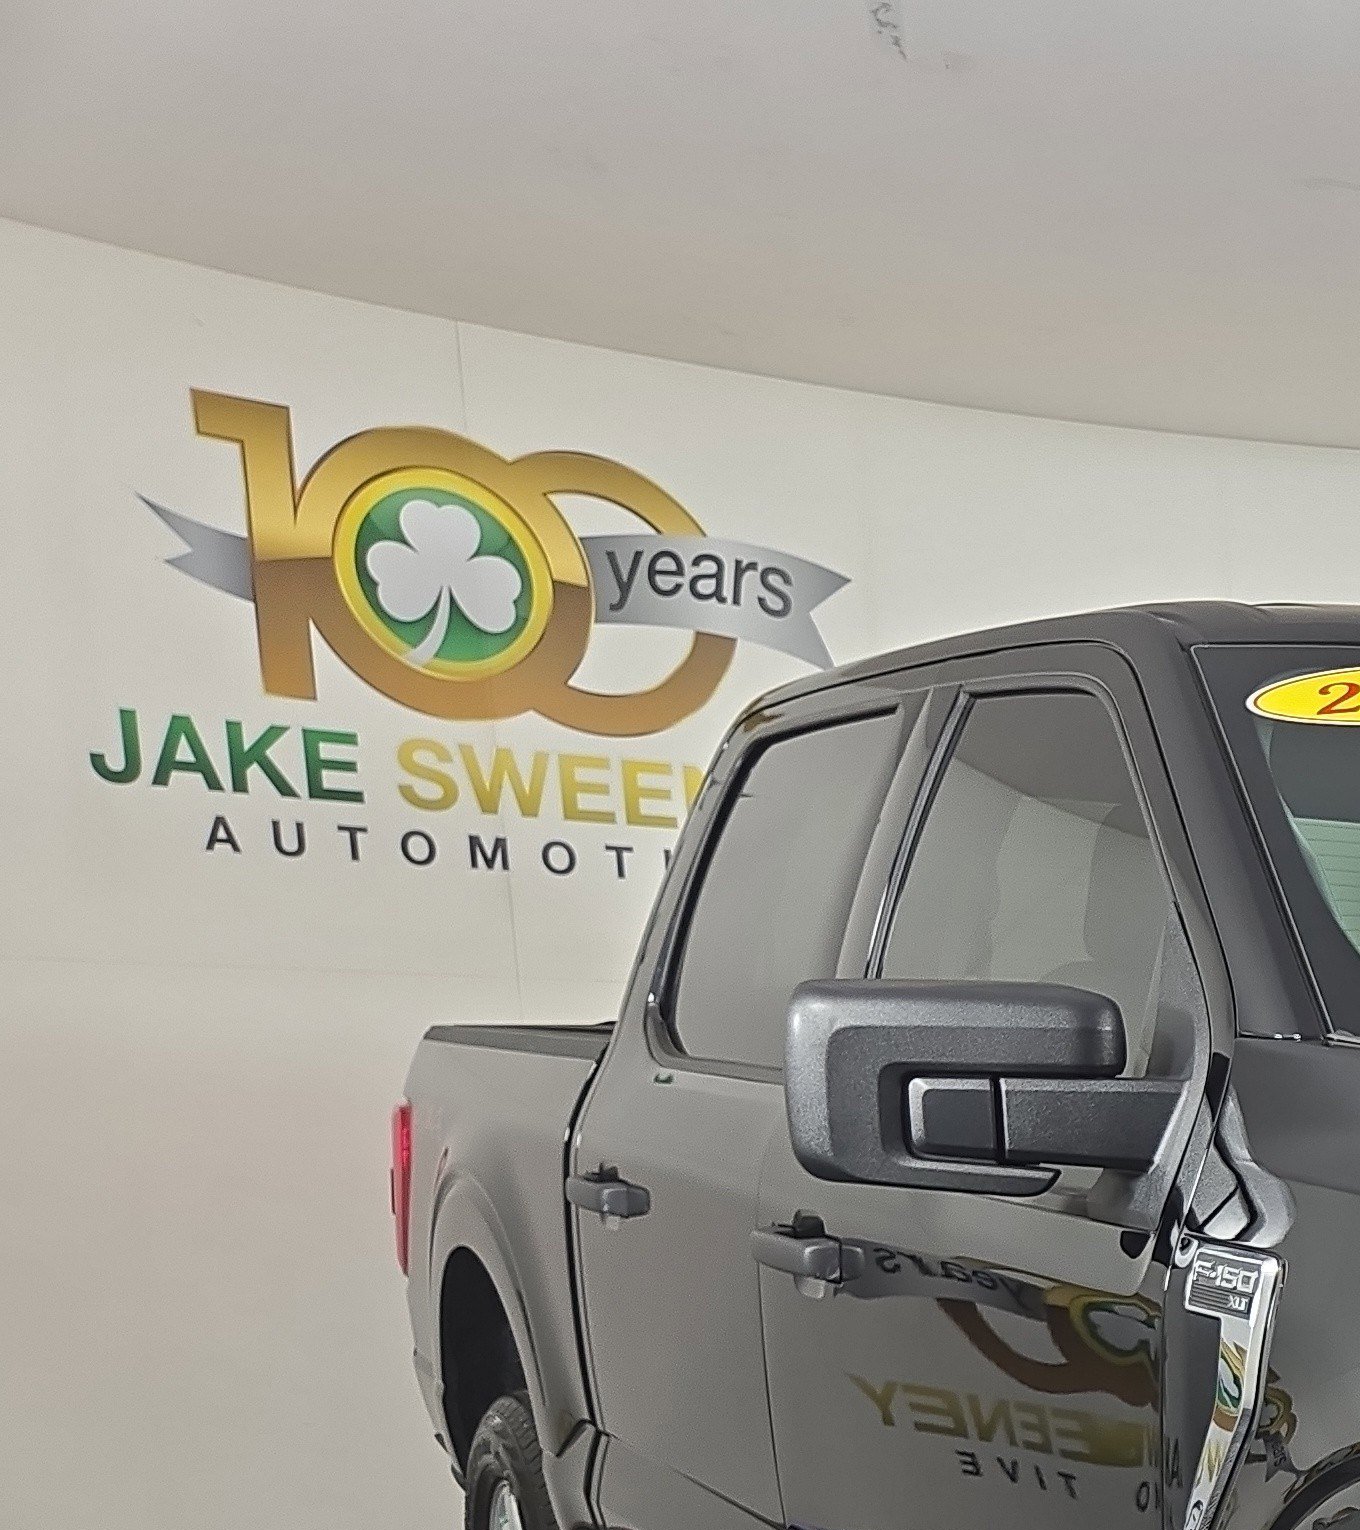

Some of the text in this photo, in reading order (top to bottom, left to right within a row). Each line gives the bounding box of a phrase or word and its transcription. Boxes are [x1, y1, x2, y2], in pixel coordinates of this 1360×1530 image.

[189, 388, 738, 738] 100
[604, 548, 794, 618] years
[89, 707, 705, 830] JAKE SWEE
